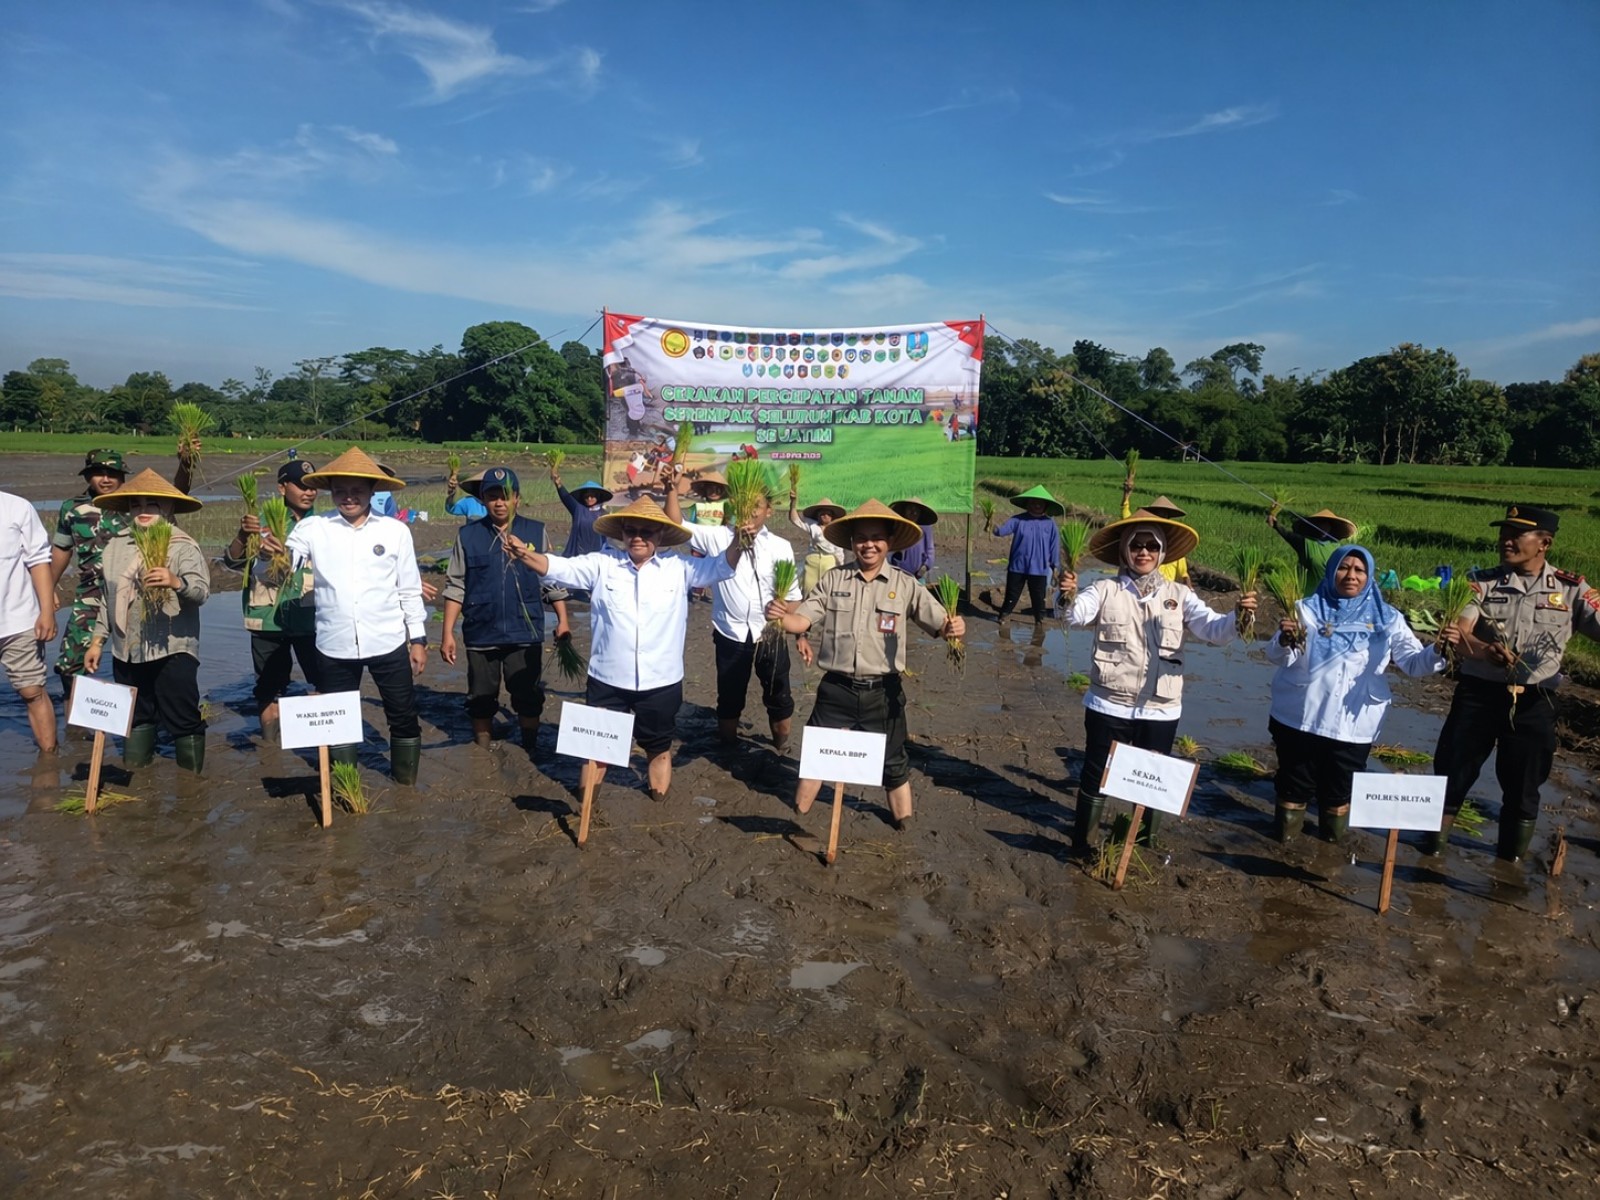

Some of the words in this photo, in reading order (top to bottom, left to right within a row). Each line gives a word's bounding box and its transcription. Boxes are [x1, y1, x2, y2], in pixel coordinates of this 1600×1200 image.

[747, 387, 857, 404] PERCEPATAN
[863, 388, 924, 405] TANAM
[758, 408, 833, 424] SELURUH
[835, 408, 871, 424] KAB
[874, 408, 923, 424] KOTA
[84, 697, 118, 709] ANGGOTA
[90, 708, 109, 717] DPRD
[295, 711, 318, 719] WAKIL
[320, 709, 346, 717] BUPATI
[572, 726, 595, 736] BUPATI
[819, 748, 847, 757] KEPALA
[1365, 793, 1399, 801] POLRES
[1400, 795, 1432, 803] BLITAR
